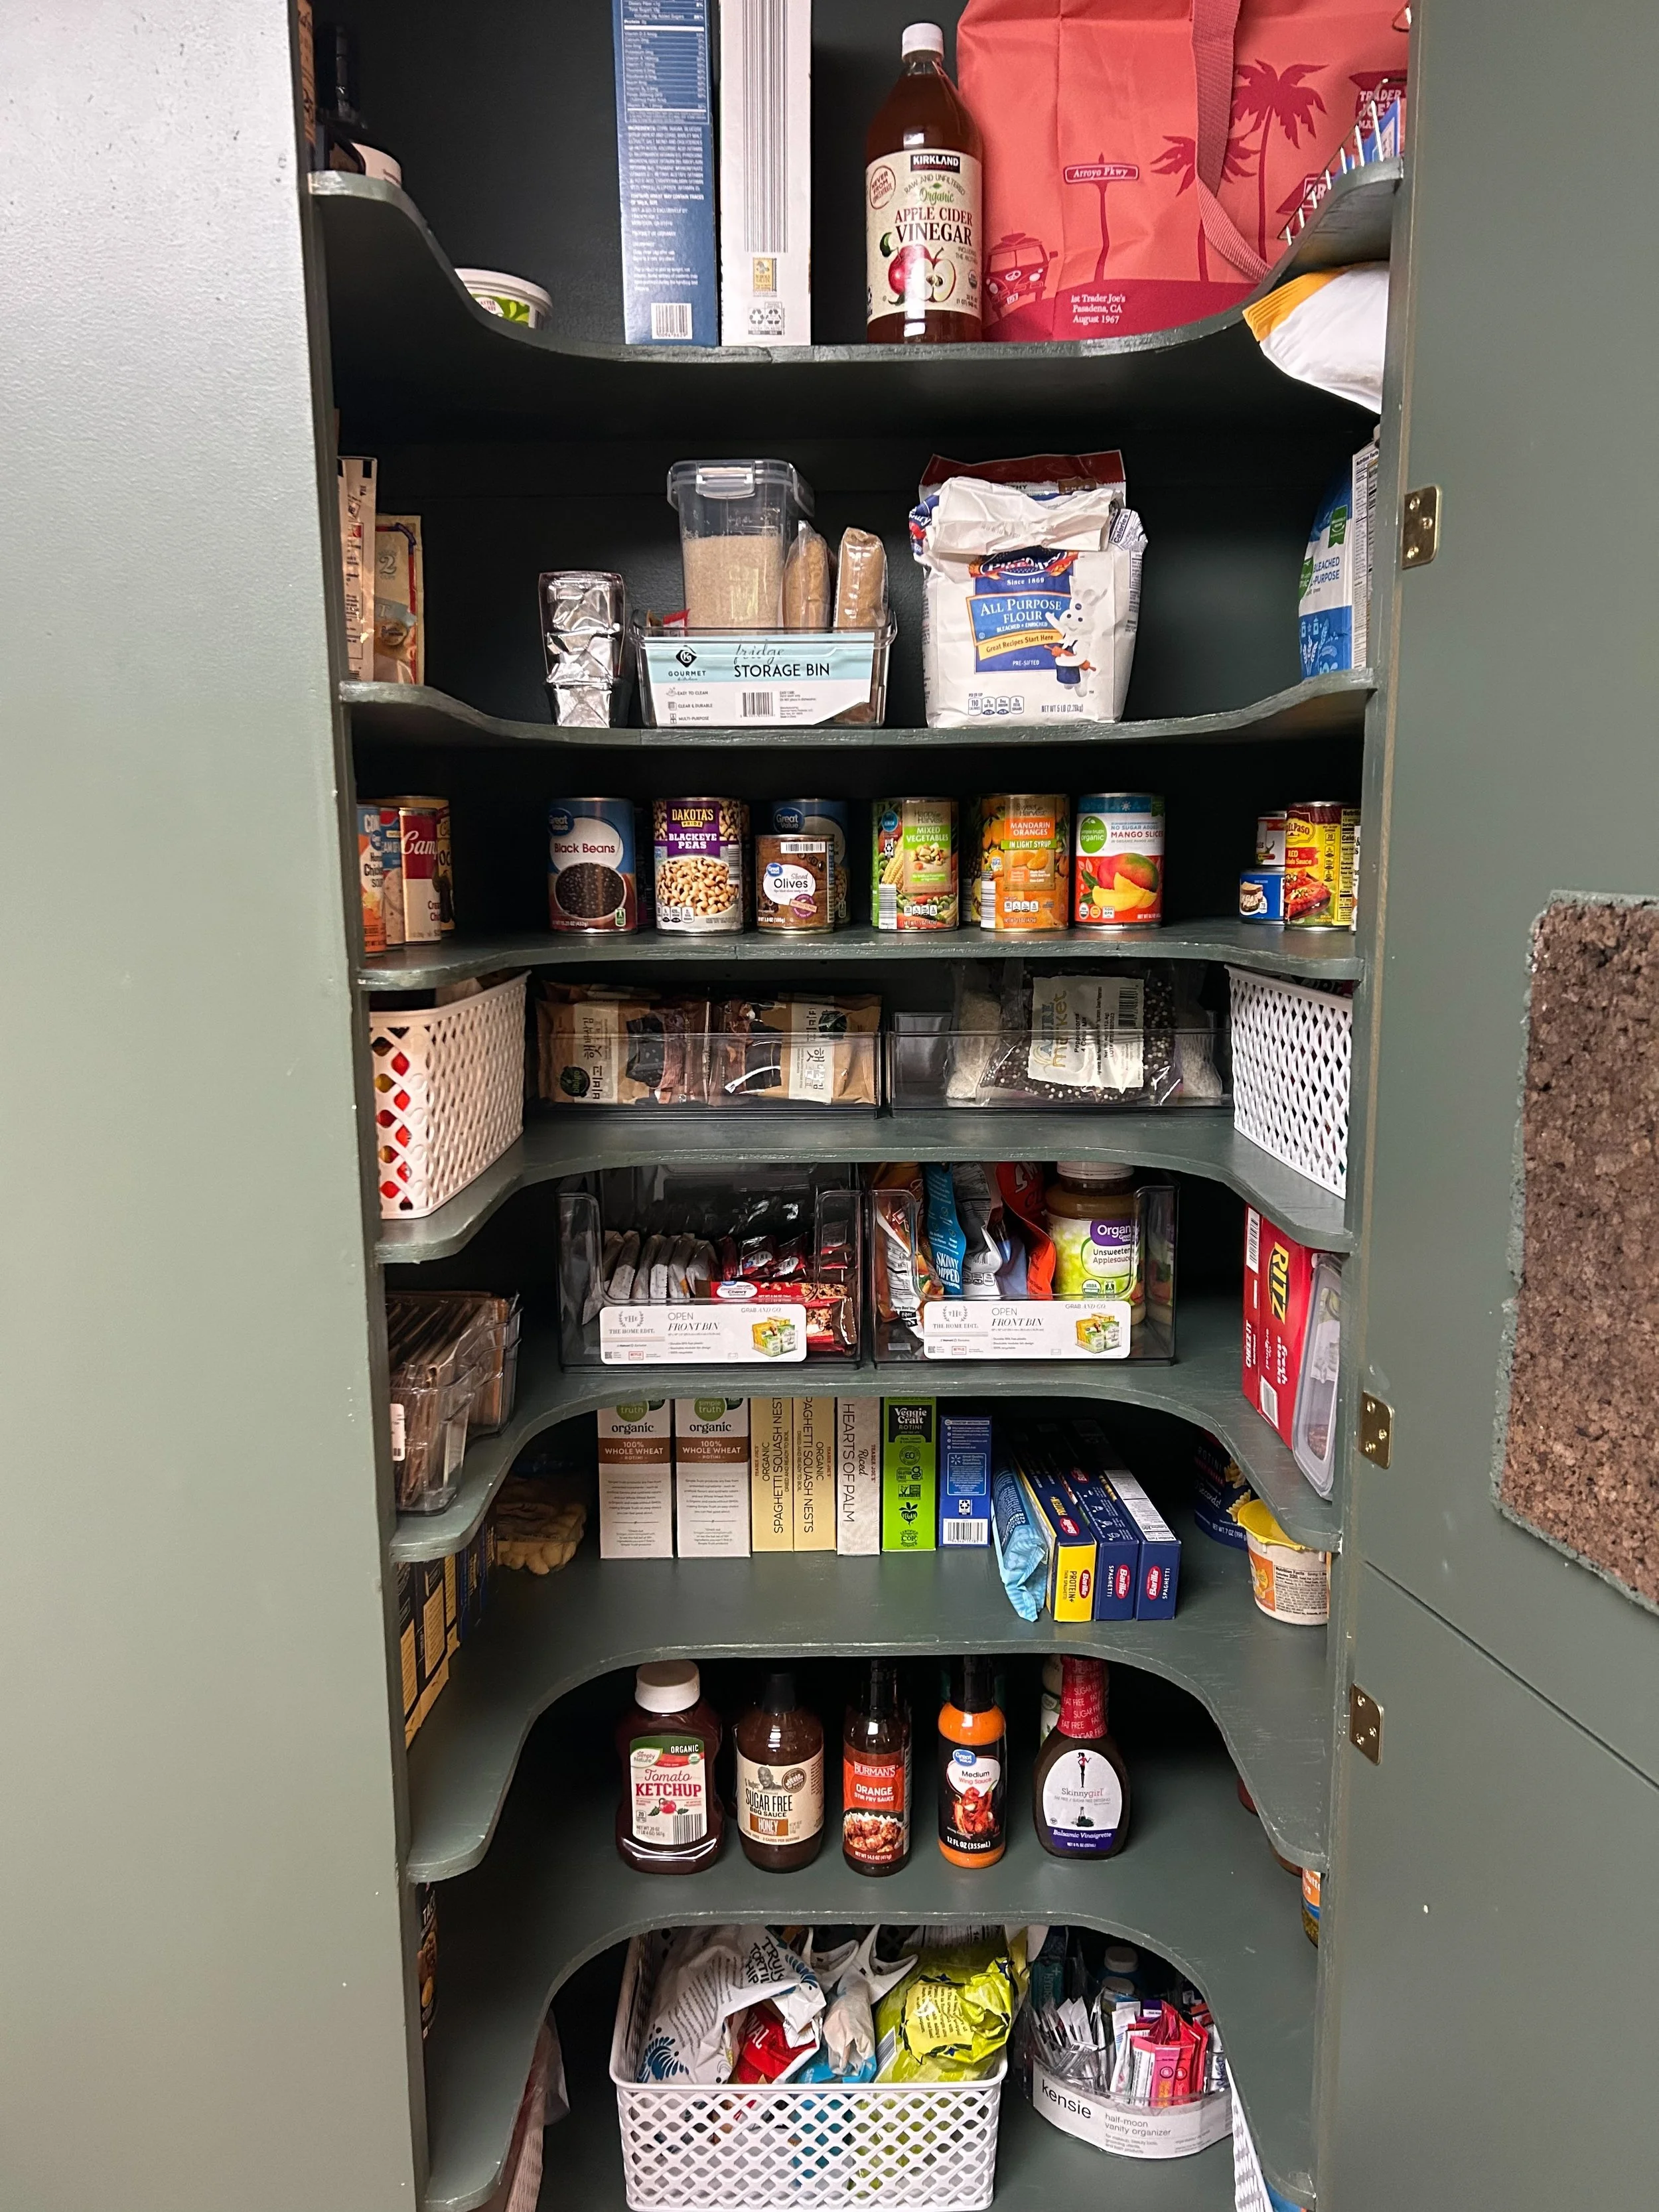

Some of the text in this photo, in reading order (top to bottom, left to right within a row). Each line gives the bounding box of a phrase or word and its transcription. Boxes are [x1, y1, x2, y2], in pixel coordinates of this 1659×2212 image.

[1360, 90, 1402, 101] TRADER
[913, 155, 959, 166] KIRKLAND
[871, 171, 889, 188] NEVER
[1074, 167, 1128, 180] Arroyo Pkwy
[873, 179, 889, 194] FROM
[904, 174, 965, 195] RAW AND UNFILTERED
[920, 186, 954, 205] Organic
[895, 207, 972, 226] APPLE CIDER
[896, 223, 972, 246] VINEGAR
[1107, 294, 1125, 303] Joe's
[1073, 305, 1122, 313] Pasadena, CA
[1073, 315, 1099, 325] August
[1114, 514, 1128, 543] Calories
[981, 599, 1061, 616] ALL PURPOSE
[1004, 611, 1042, 623] FLOUR
[997, 623, 1020, 632] BLEACHED
[734, 640, 784, 664] fridge
[987, 642, 1001, 652] Great
[735, 664, 830, 677] STORAGE BIN
[672, 809, 713, 821] DAKOTA'S
[776, 814, 799, 824] Great
[1294, 824, 1310, 834] Paso
[554, 843, 615, 853] Black Beans
[773, 878, 808, 889] Olives
[592, 1066, 603, 1099] 비비고
[936, 1266, 960, 1284] DIPPED
[1271, 1242, 1289, 1325] RITZ
[668, 1323, 702, 1331] FRONT
[895, 1408, 927, 1419] Veggie
[612, 1422, 654, 1434] organic
[689, 1422, 732, 1434] organic
[843, 1404, 855, 1522] HEARTS OF PALM
[859, 1449, 869, 1476] Riced
[773, 1427, 783, 1533] SPAGHETTI SQUASH
[804, 1451, 813, 1532] SQUASH NESTS
[1118, 1568, 1128, 1595] Barilla
[1149, 1568, 1159, 1596] Barilla
[1074, 1684, 1092, 1696] SUGAR
[1074, 1708, 1092, 1718] SUGAR
[671, 1745, 699, 1753] ORGANIC
[956, 1752, 972, 1761] Great
[645, 1769, 692, 1781] Tomato
[855, 1764, 895, 1777] BURMAN'S
[636, 1783, 701, 1797] KETCHUP
[856, 1784, 893, 1796] ORANGE
[1062, 1788, 1104, 1798] Skinnygirl
[746, 1789, 792, 1812] SUGAR FREE
[750, 1806, 762, 1815] BBQ
[758, 1818, 778, 1832] HONEY
[1053, 1829, 1080, 1838] Balsamic
[968, 1841, 991, 1850] (355mL)
[1042, 2079, 1092, 2118] kensie
[1106, 2112, 1148, 2128] half-moon
[1106, 2123, 1171, 2137] vanity organizer
